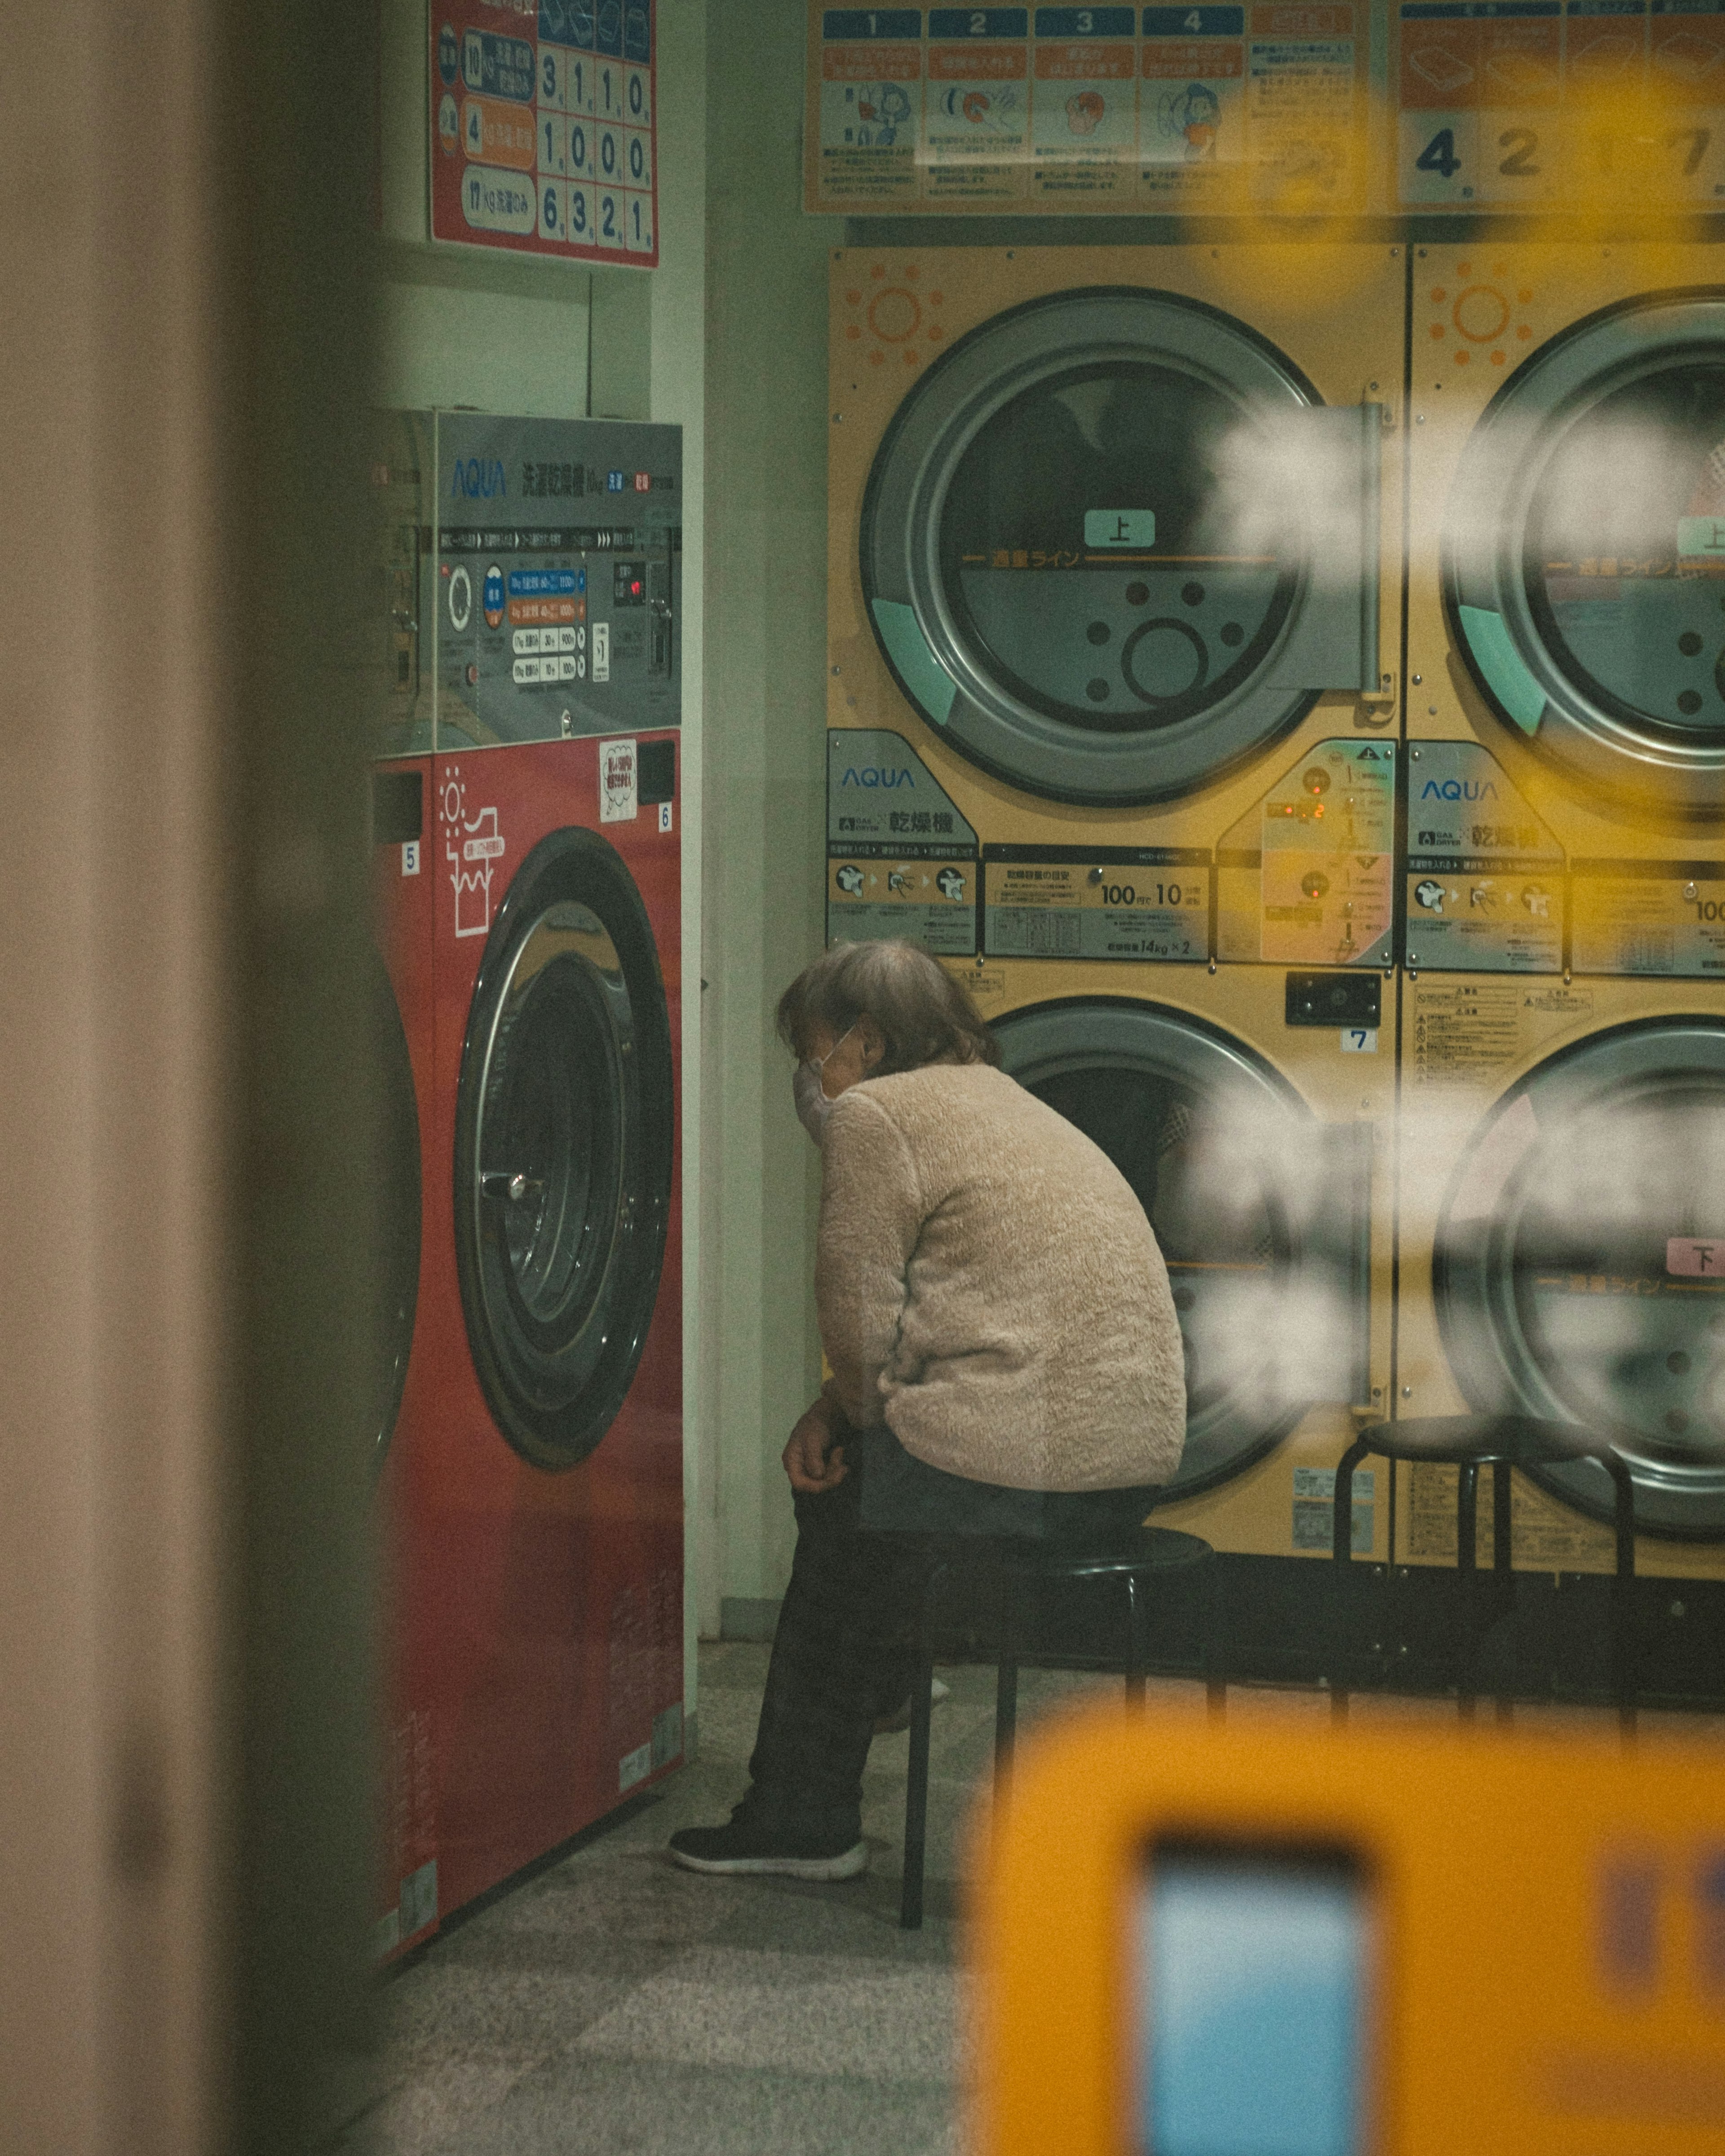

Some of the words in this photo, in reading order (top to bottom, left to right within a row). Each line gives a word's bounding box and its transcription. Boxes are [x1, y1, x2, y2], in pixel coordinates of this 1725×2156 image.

[869, 14, 876, 35] 1
[970, 13, 986, 34] 2
[1077, 11, 1093, 32] 3
[1184, 10, 1202, 31] 4
[543, 55, 556, 97] 3
[629, 74, 642, 115] 0
[571, 126, 585, 168] 0
[602, 133, 615, 174] 0
[630, 138, 643, 179] 0
[1415, 128, 1461, 178] 4
[1499, 128, 1540, 176] 2
[544, 187, 557, 230] 6
[573, 190, 586, 233] 3
[602, 196, 615, 237] 2
[451, 458, 506, 498] AQUA
[1109, 516, 1130, 541] 上
[1703, 524, 1725, 549] 上
[842, 767, 916, 788] AQUA
[1421, 780, 1498, 801] AQUA
[663, 807, 668, 827] 6
[407, 847, 415, 869] 5
[1101, 884, 1135, 905] 100
[1156, 884, 1181, 906] 10
[1182, 941, 1191, 955] 2
[1351, 1030, 1367, 1049] 7
[1693, 1246, 1714, 1272] 下
